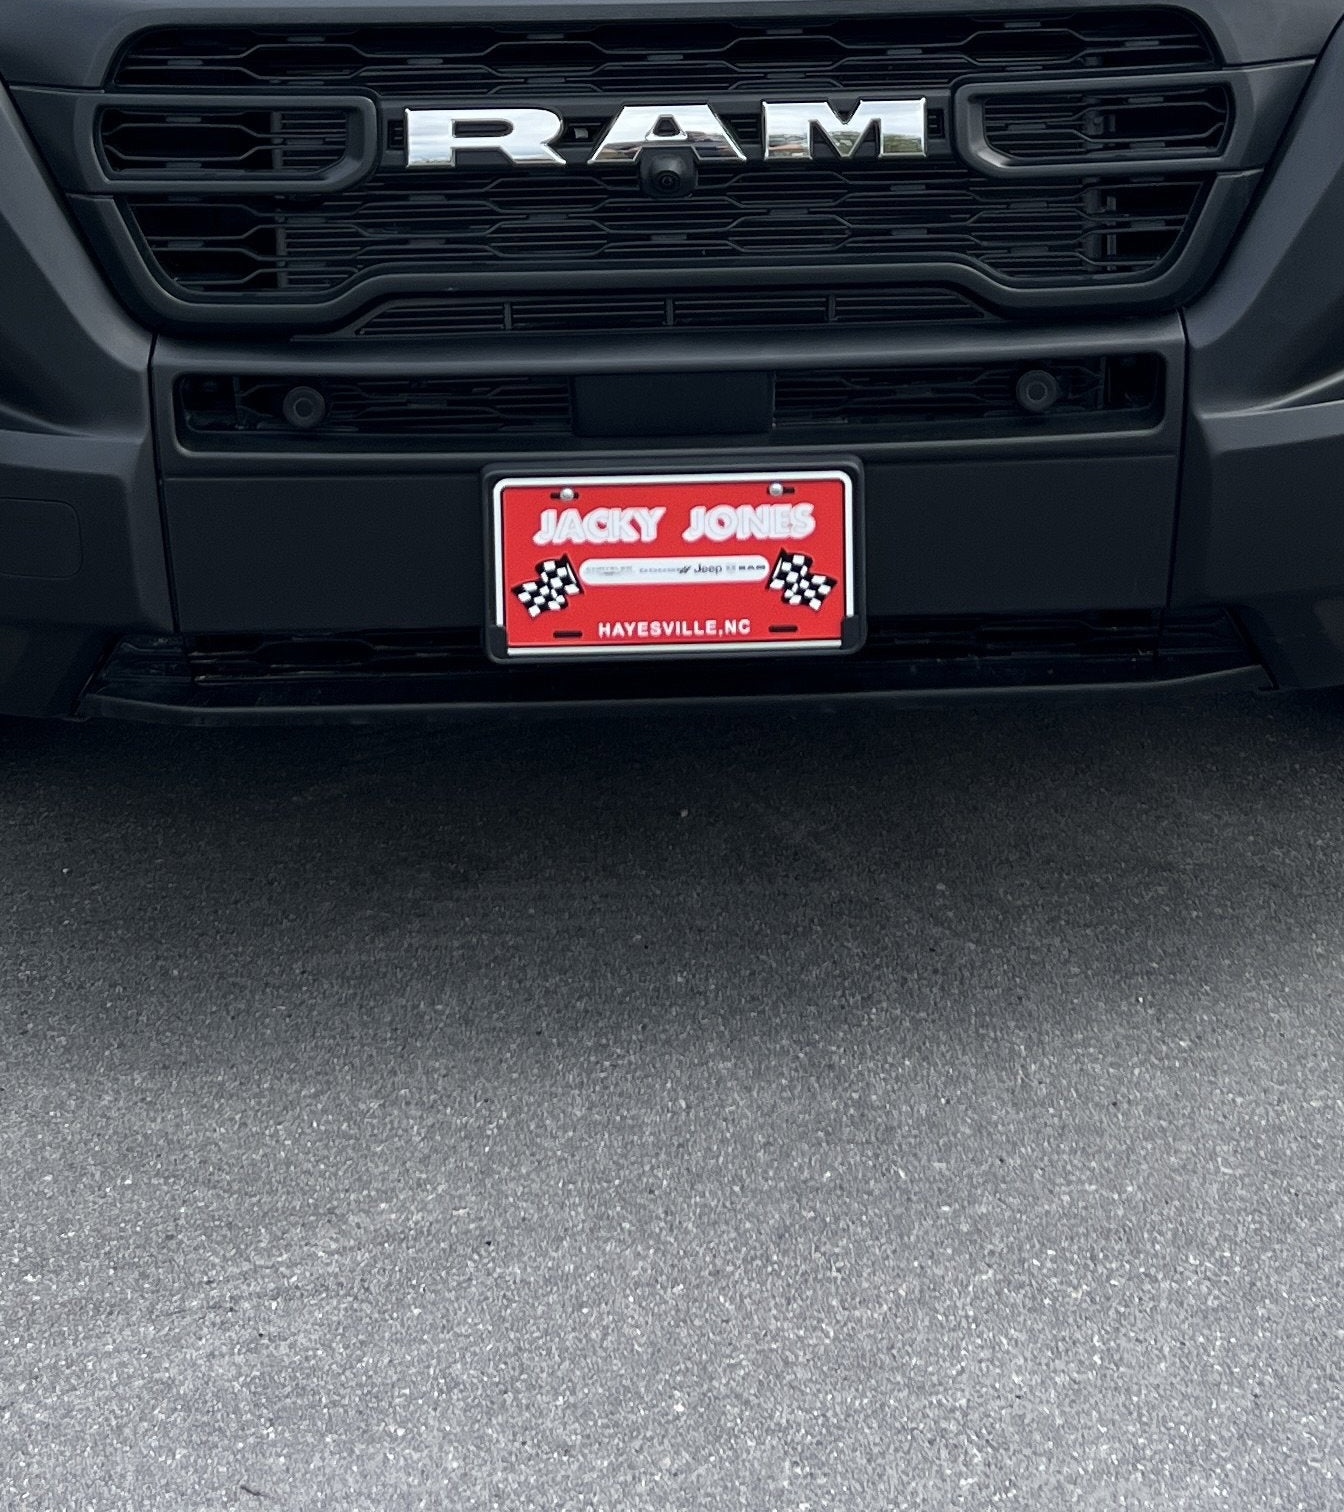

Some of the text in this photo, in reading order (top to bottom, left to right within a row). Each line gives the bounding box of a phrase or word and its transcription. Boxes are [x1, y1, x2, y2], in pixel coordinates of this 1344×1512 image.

[404, 97, 928, 168] RAM
[532, 502, 817, 546] JACKY JONES
[693, 563, 723, 575] Jeep
